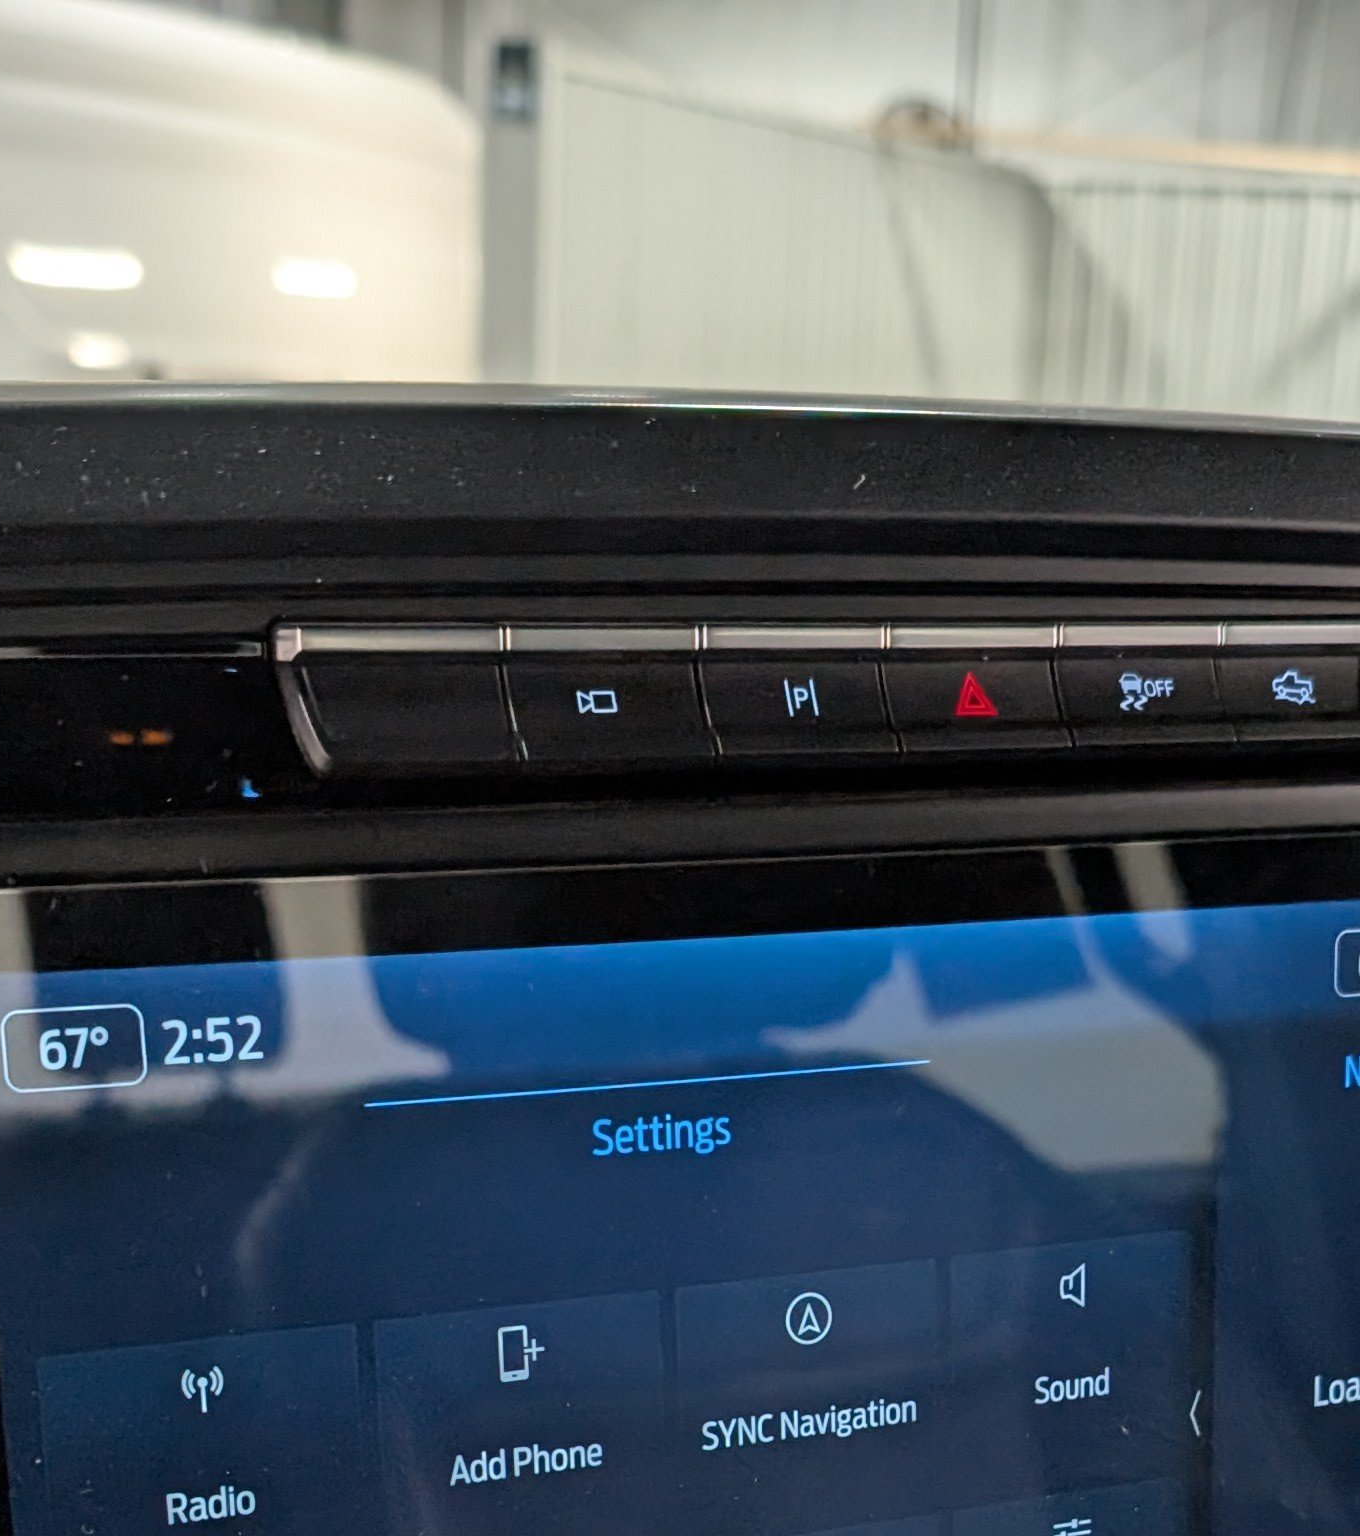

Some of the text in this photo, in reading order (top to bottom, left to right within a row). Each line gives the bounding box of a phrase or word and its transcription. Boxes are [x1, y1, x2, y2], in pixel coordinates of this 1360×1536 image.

[1144, 678, 1175, 700] OFF
[38, 1026, 109, 1071] 67°
[161, 1014, 264, 1065] 2:52
[592, 1113, 732, 1157] Settings
[1034, 1366, 1110, 1405] Sound
[702, 1398, 917, 1451] SYNC Navigation
[450, 1443, 603, 1486] Add Phone
[165, 1485, 256, 1525] Radio
